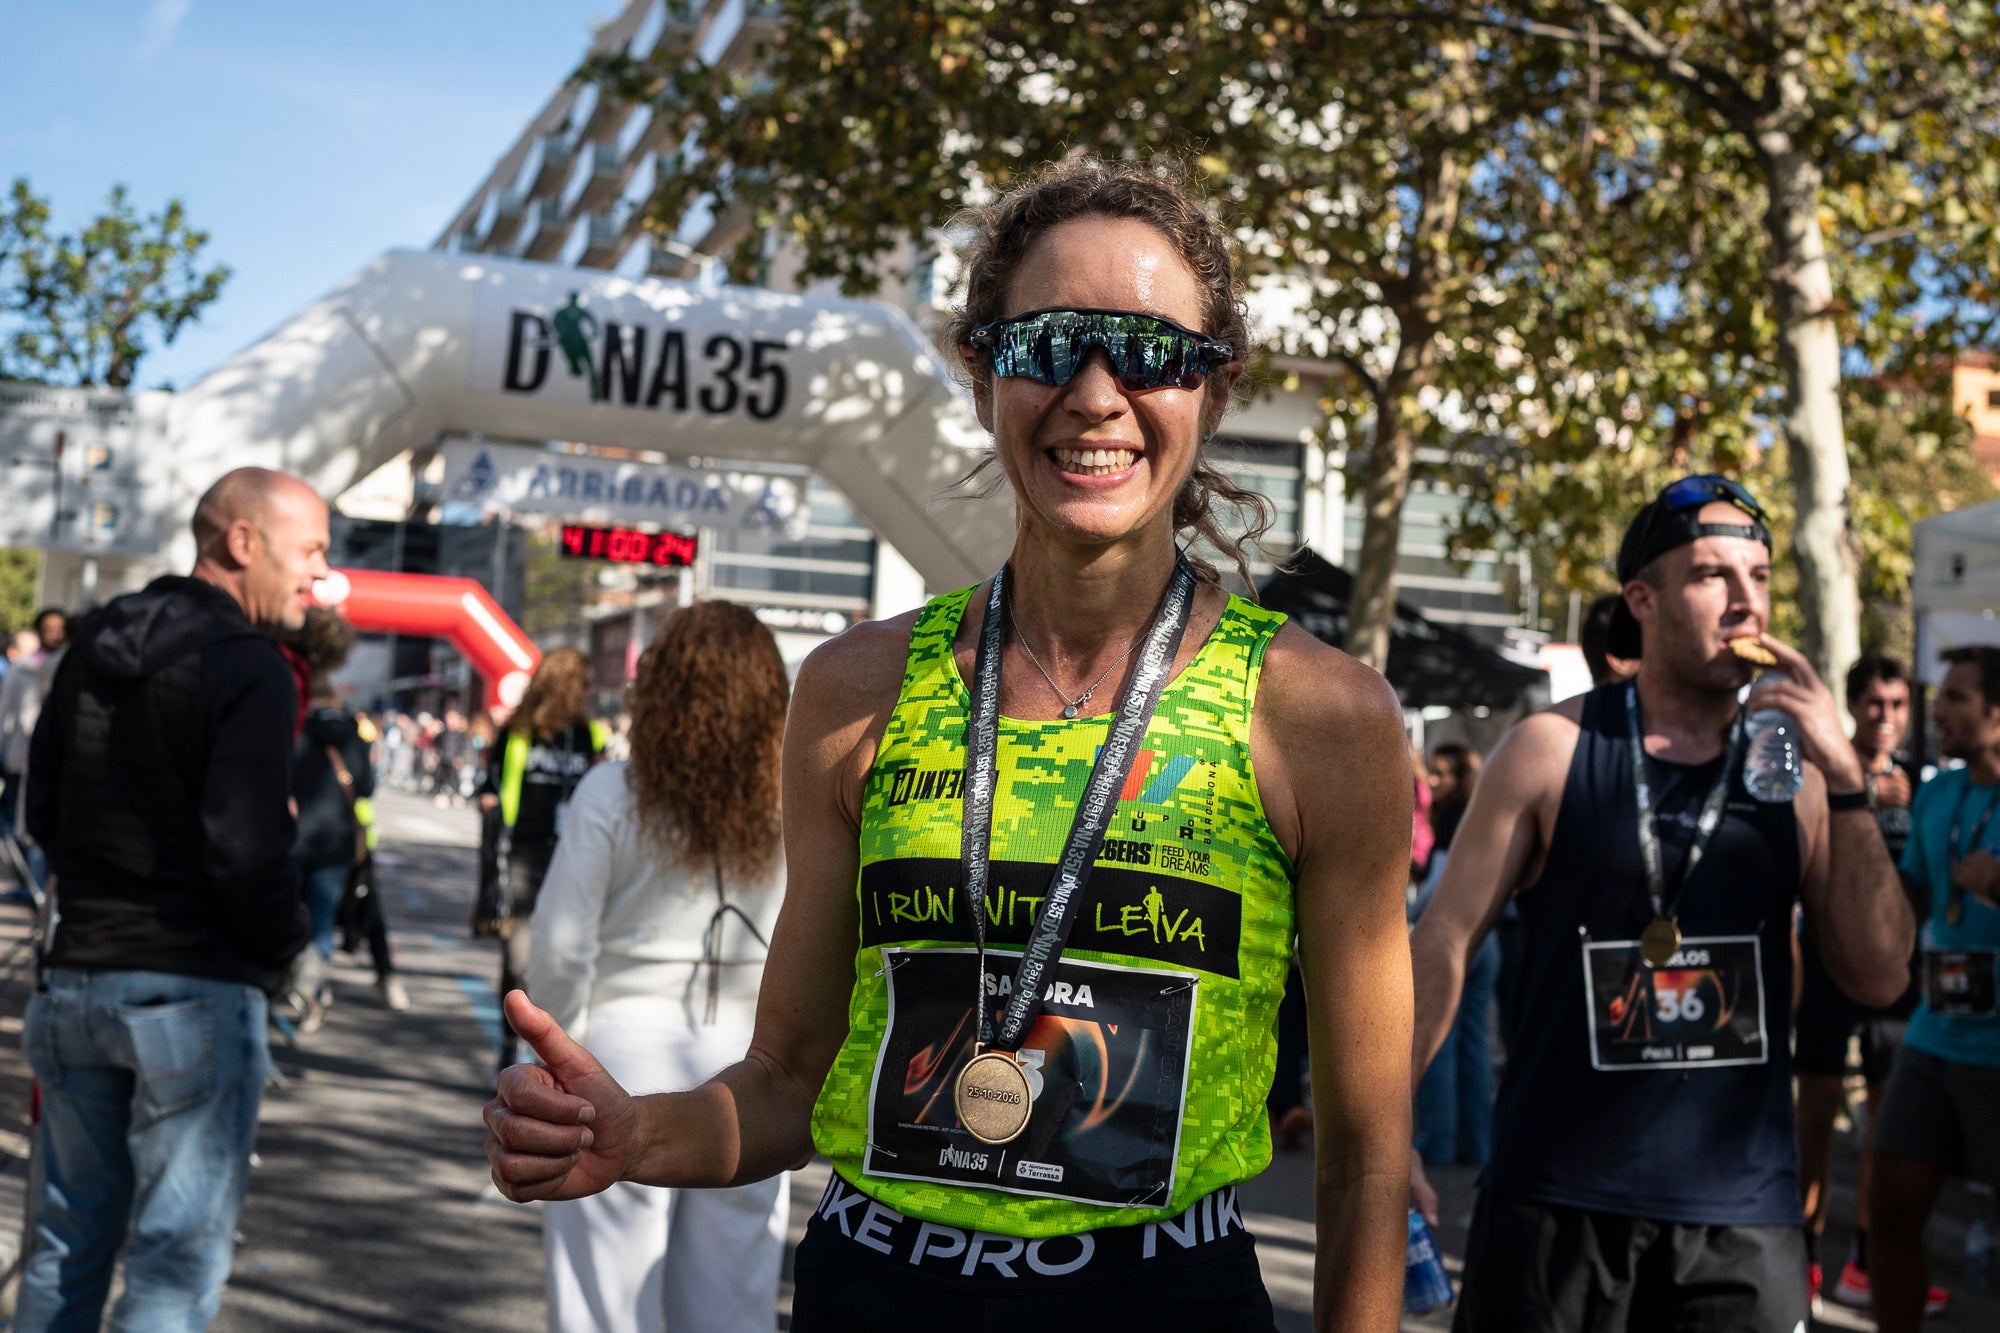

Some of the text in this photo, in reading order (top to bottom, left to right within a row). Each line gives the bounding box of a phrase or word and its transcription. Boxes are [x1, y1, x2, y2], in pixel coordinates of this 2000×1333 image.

[1203, 761, 1218, 845] BARCELONA
[1160, 855, 1210, 877] DREAMS
[1161, 845, 1211, 864] FEED YOUR
[888, 886, 955, 924] RUN
[1028, 960, 1044, 984] Pau
[1656, 988, 1705, 1022] 36
[967, 1086, 1021, 1104] 25-10-2026
[1028, 1169, 1060, 1180] Terrassa
[909, 1221, 1096, 1279] PRO
